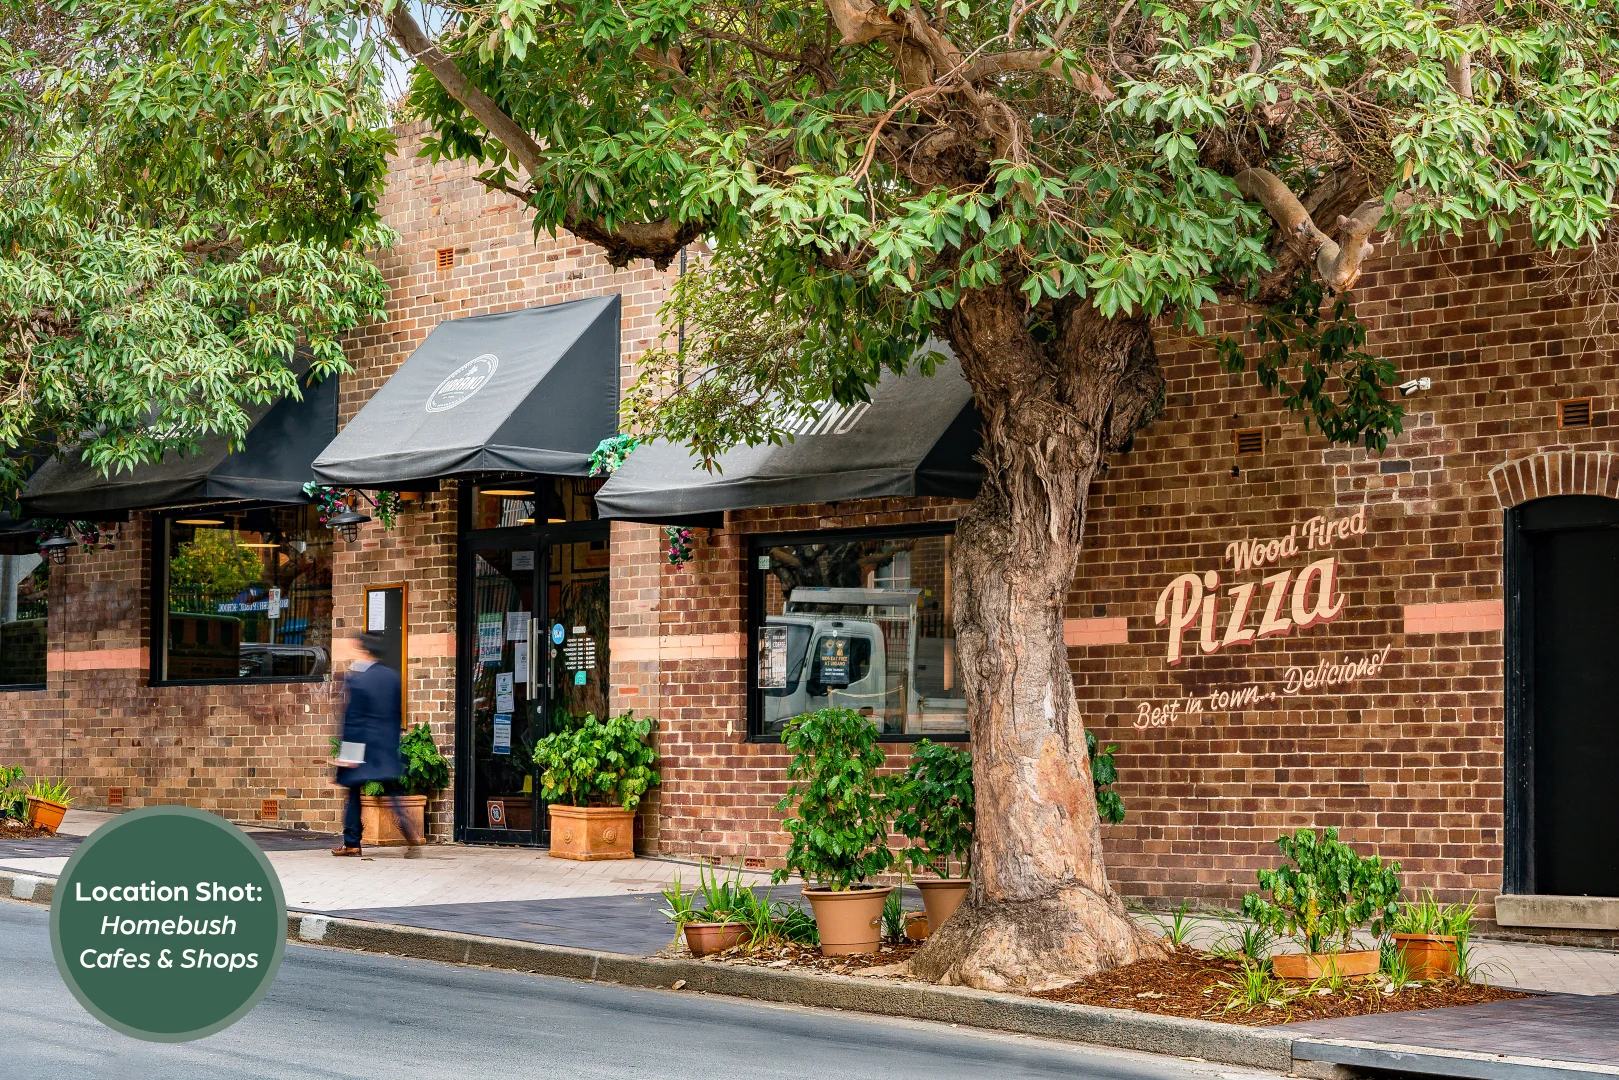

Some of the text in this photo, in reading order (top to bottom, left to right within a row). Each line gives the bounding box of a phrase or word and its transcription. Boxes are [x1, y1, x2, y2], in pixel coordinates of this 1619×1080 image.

[1226, 506, 1366, 574] Wood Fired
[1155, 557, 1346, 666] Pizza
[1134, 699, 1180, 730] Best
[1186, 692, 1204, 715] in
[1283, 643, 1391, 694] Delicious!
